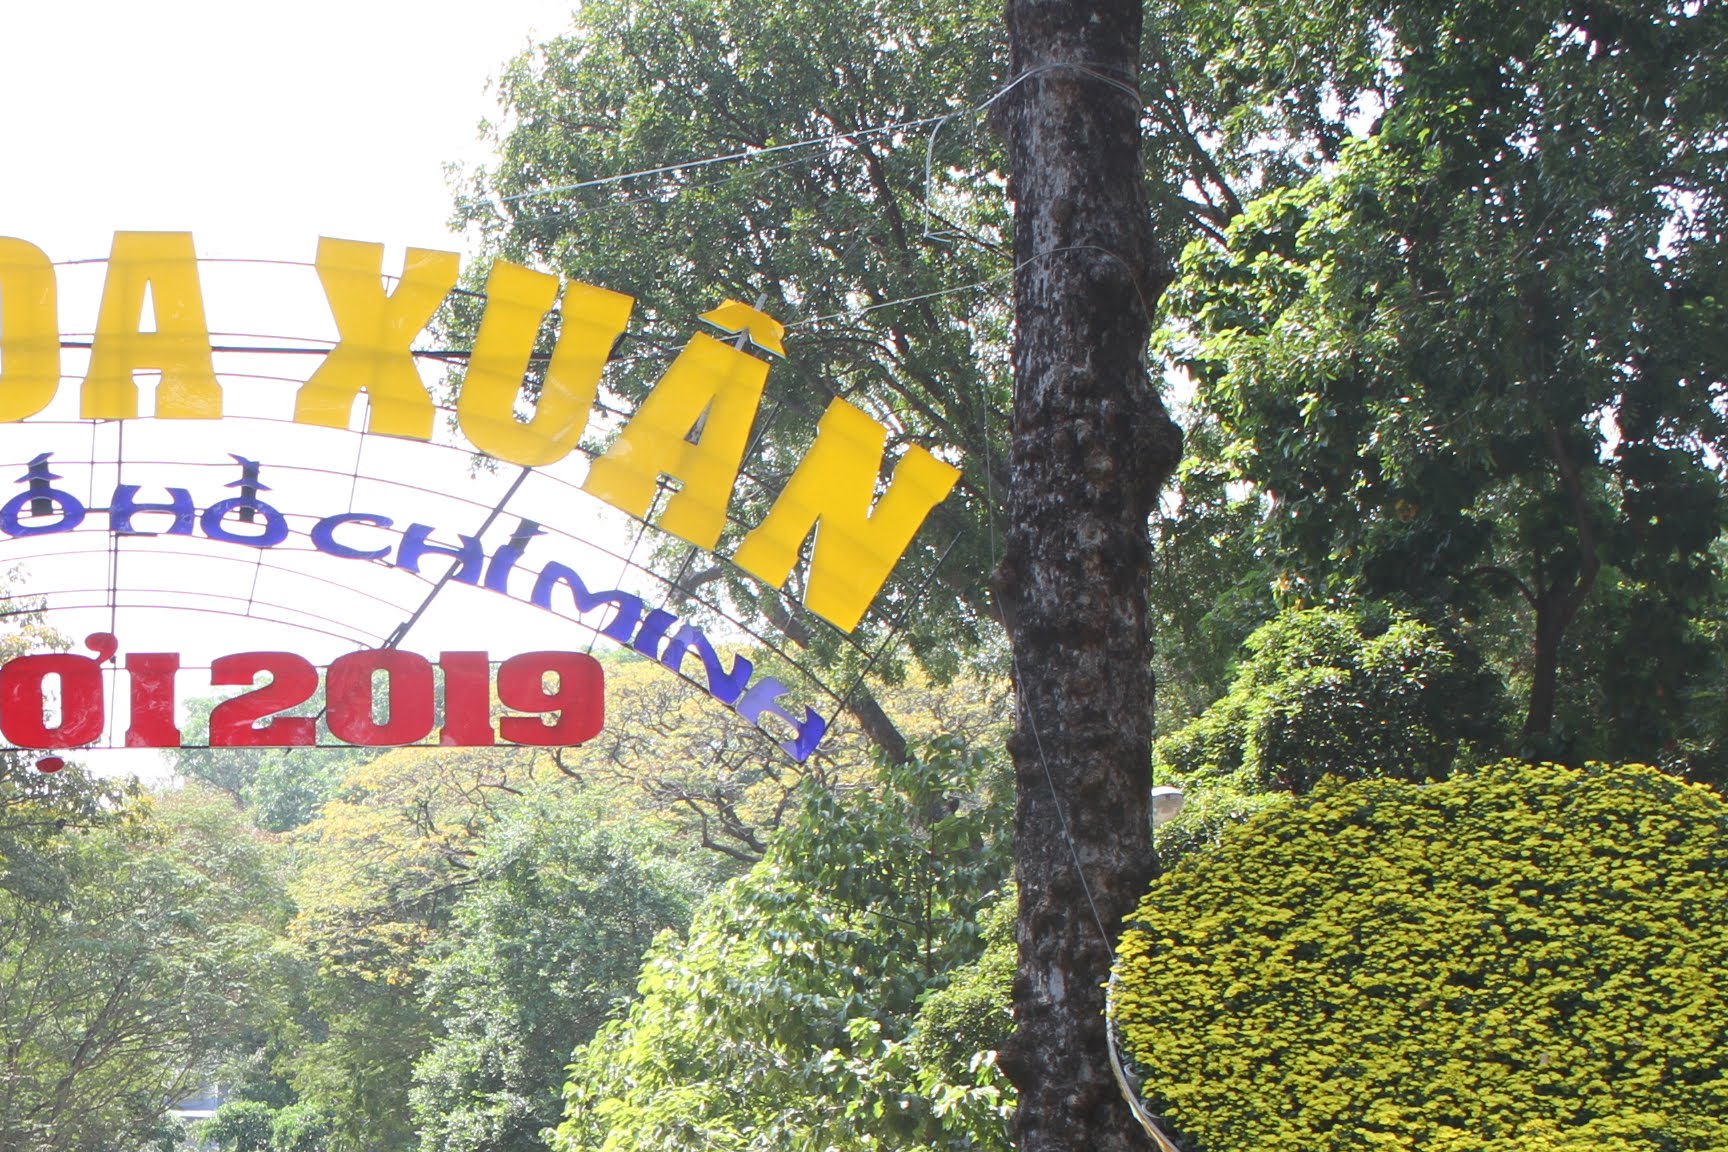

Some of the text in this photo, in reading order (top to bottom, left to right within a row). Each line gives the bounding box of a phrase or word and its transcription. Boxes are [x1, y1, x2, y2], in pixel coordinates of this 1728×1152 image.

[294, 236, 962, 633] XUÂN
[110, 453, 289, 548] HỒ
[311, 513, 548, 595] CHÍ
[210, 650, 605, 747] 2019
